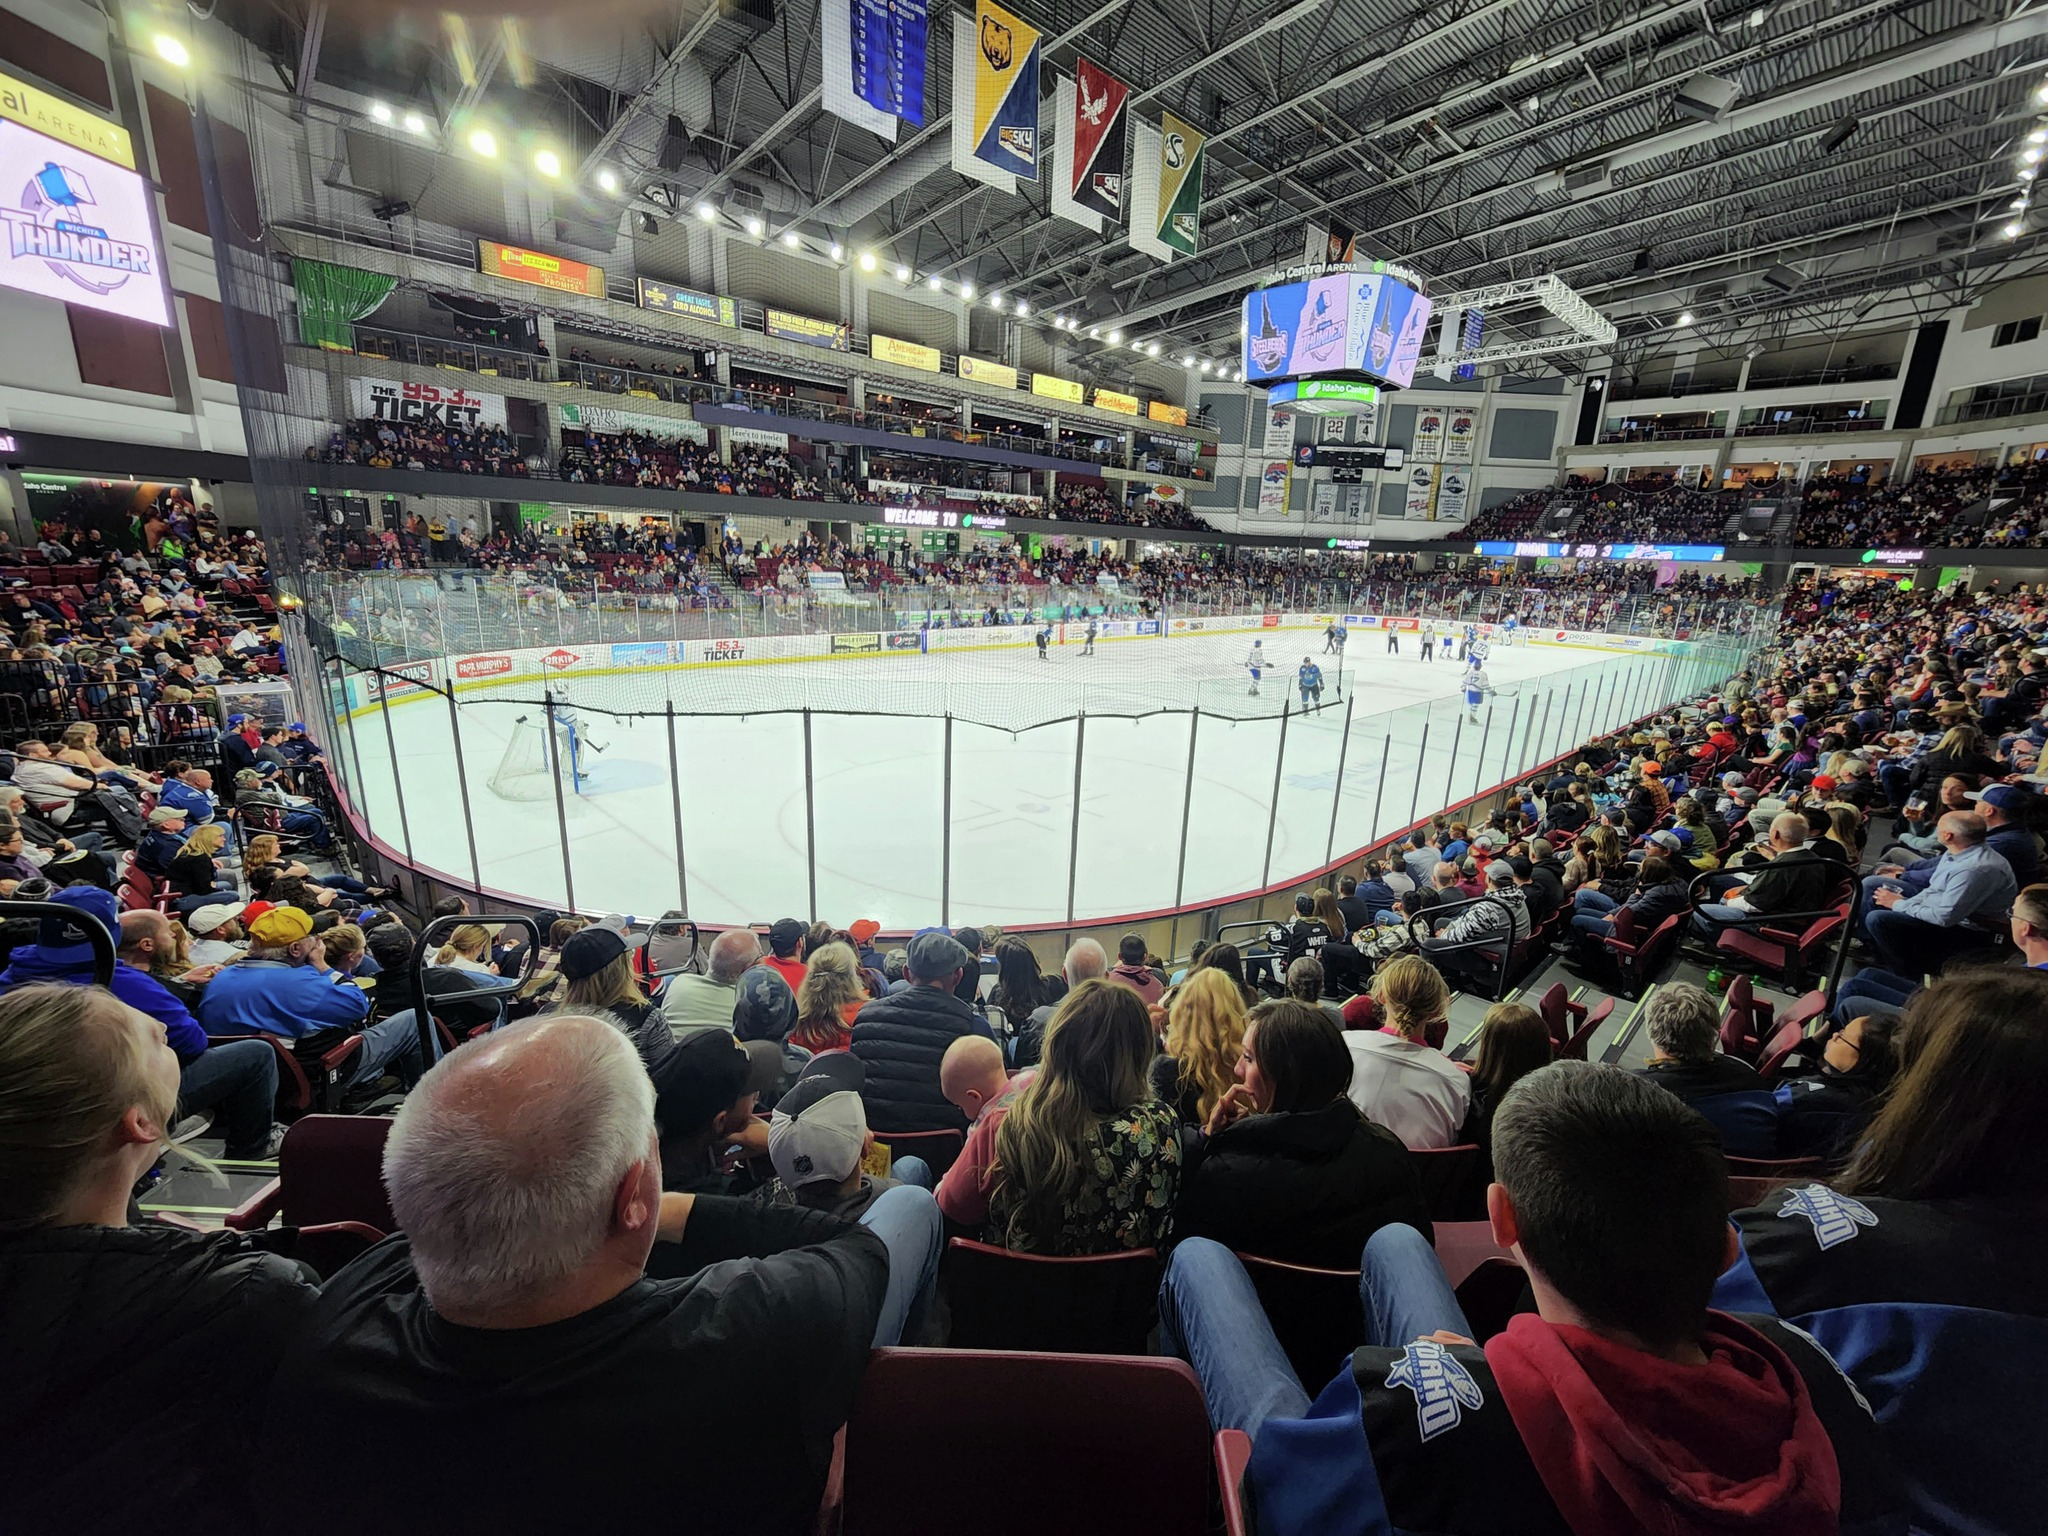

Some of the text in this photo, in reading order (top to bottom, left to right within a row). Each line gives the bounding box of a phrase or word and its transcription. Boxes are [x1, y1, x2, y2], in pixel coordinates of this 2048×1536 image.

[37, 110, 107, 150] ARENA
[64, 222, 101, 237] WICHITA
[0, 206, 151, 275] THUNDER
[1286, 262, 1327, 278] Central
[1326, 263, 1358, 272] ARENA
[1386, 263, 1409, 280] Idaho
[676, 293, 695, 304] GREAT
[695, 297, 713, 308] TASTE.
[673, 301, 716, 317] ZERO ALCOHOL.
[1301, 321, 1344, 356] THUNDER
[888, 340, 927, 356] AMERICAN
[372, 381, 481, 407] THE 95.3 FM
[1322, 384, 1370, 395] Idaho Central
[370, 395, 480, 430] TICKET
[580, 405, 616, 418] IDAHO
[581, 415, 618, 428] PRESS
[1327, 420, 1344, 433] 22
[760, 433, 783, 441] stories
[1362, 425, 1369, 436] 4
[41, 483, 67, 491] Central
[1320, 506, 1330, 515] 16
[1350, 507, 1360, 517] 12
[884, 508, 958, 527] WELCOME TO
[972, 516, 1006, 526] Idaho Central
[1560, 544, 1570, 555] 4
[1601, 545, 1612, 557] 3
[1876, 551, 1923, 559] Idaho Central
[715, 640, 739, 650] 95.3
[1478, 643, 1488, 651] 72
[545, 655, 575, 665] ORKIN
[704, 649, 745, 661] TICKET
[459, 658, 509, 673] PAPA MURPHY'S
[367, 665, 430, 692] SADOWS
[1307, 935, 1328, 947] WHITE
